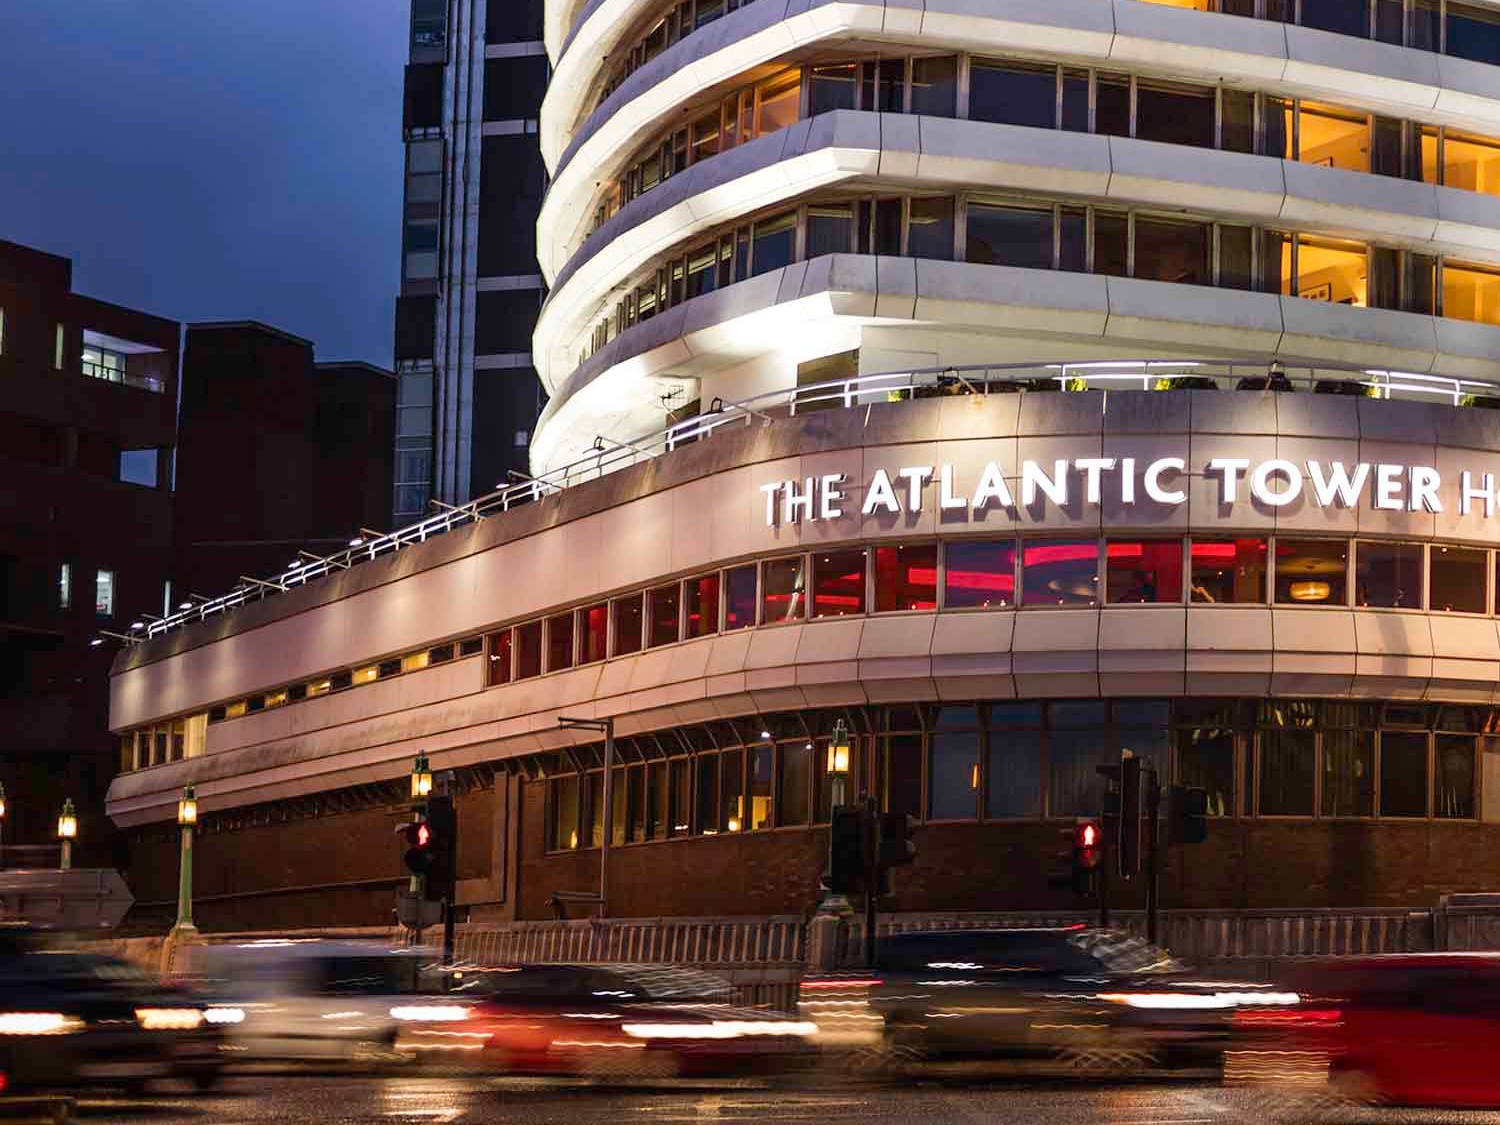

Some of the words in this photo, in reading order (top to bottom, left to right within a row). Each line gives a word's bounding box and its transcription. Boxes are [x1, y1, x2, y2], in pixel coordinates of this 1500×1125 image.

[760, 474, 846, 526] THE
[861, 457, 1187, 513] ATLANTIC
[1209, 458, 1444, 513] TOWER
